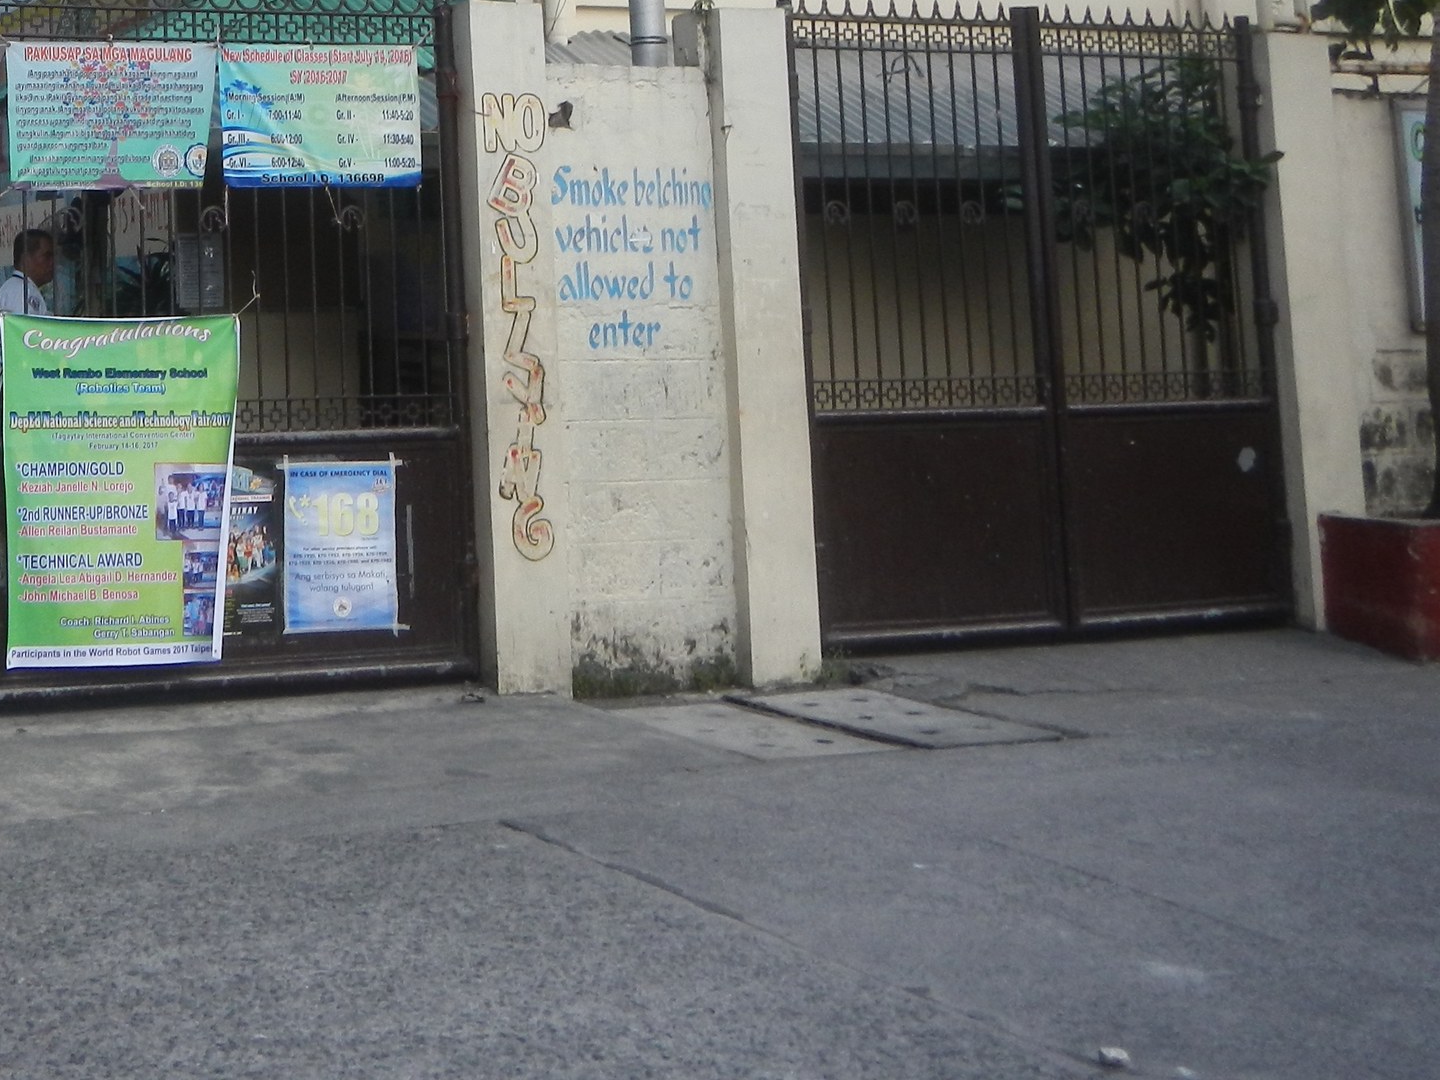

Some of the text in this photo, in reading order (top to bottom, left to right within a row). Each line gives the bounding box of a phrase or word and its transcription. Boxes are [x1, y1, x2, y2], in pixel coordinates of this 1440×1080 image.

[24, 46, 82, 62] PAKIUSAP
[101, 47, 127, 62] MGA
[128, 46, 192, 63] MAGULANG
[223, 49, 243, 63] New
[244, 49, 283, 63] Schedule
[295, 49, 328, 64] Classes
[481, 93, 546, 153] NO
[262, 173, 309, 184] School
[338, 173, 385, 184] 136698
[551, 165, 629, 209] Smoke
[554, 215, 701, 255] vehicles not
[559, 260, 694, 301] allowed to
[588, 310, 661, 350] enter
[22, 321, 212, 359] Congratulations
[32, 367, 208, 380] West Rembo Elementary School
[75, 383, 166, 395] (Robotics Team)
[10, 411, 232, 433] DepEd National Science and Technology Fair 2017
[55, 481, 88, 493] Janelle
[104, 480, 135, 494] Lorejo
[48, 524, 77, 536] Reilan
[81, 523, 137, 536] Bustamante
[97, 552, 143, 568] AWARD
[50, 589, 87, 601] Michael
[102, 588, 139, 600] Benosa
